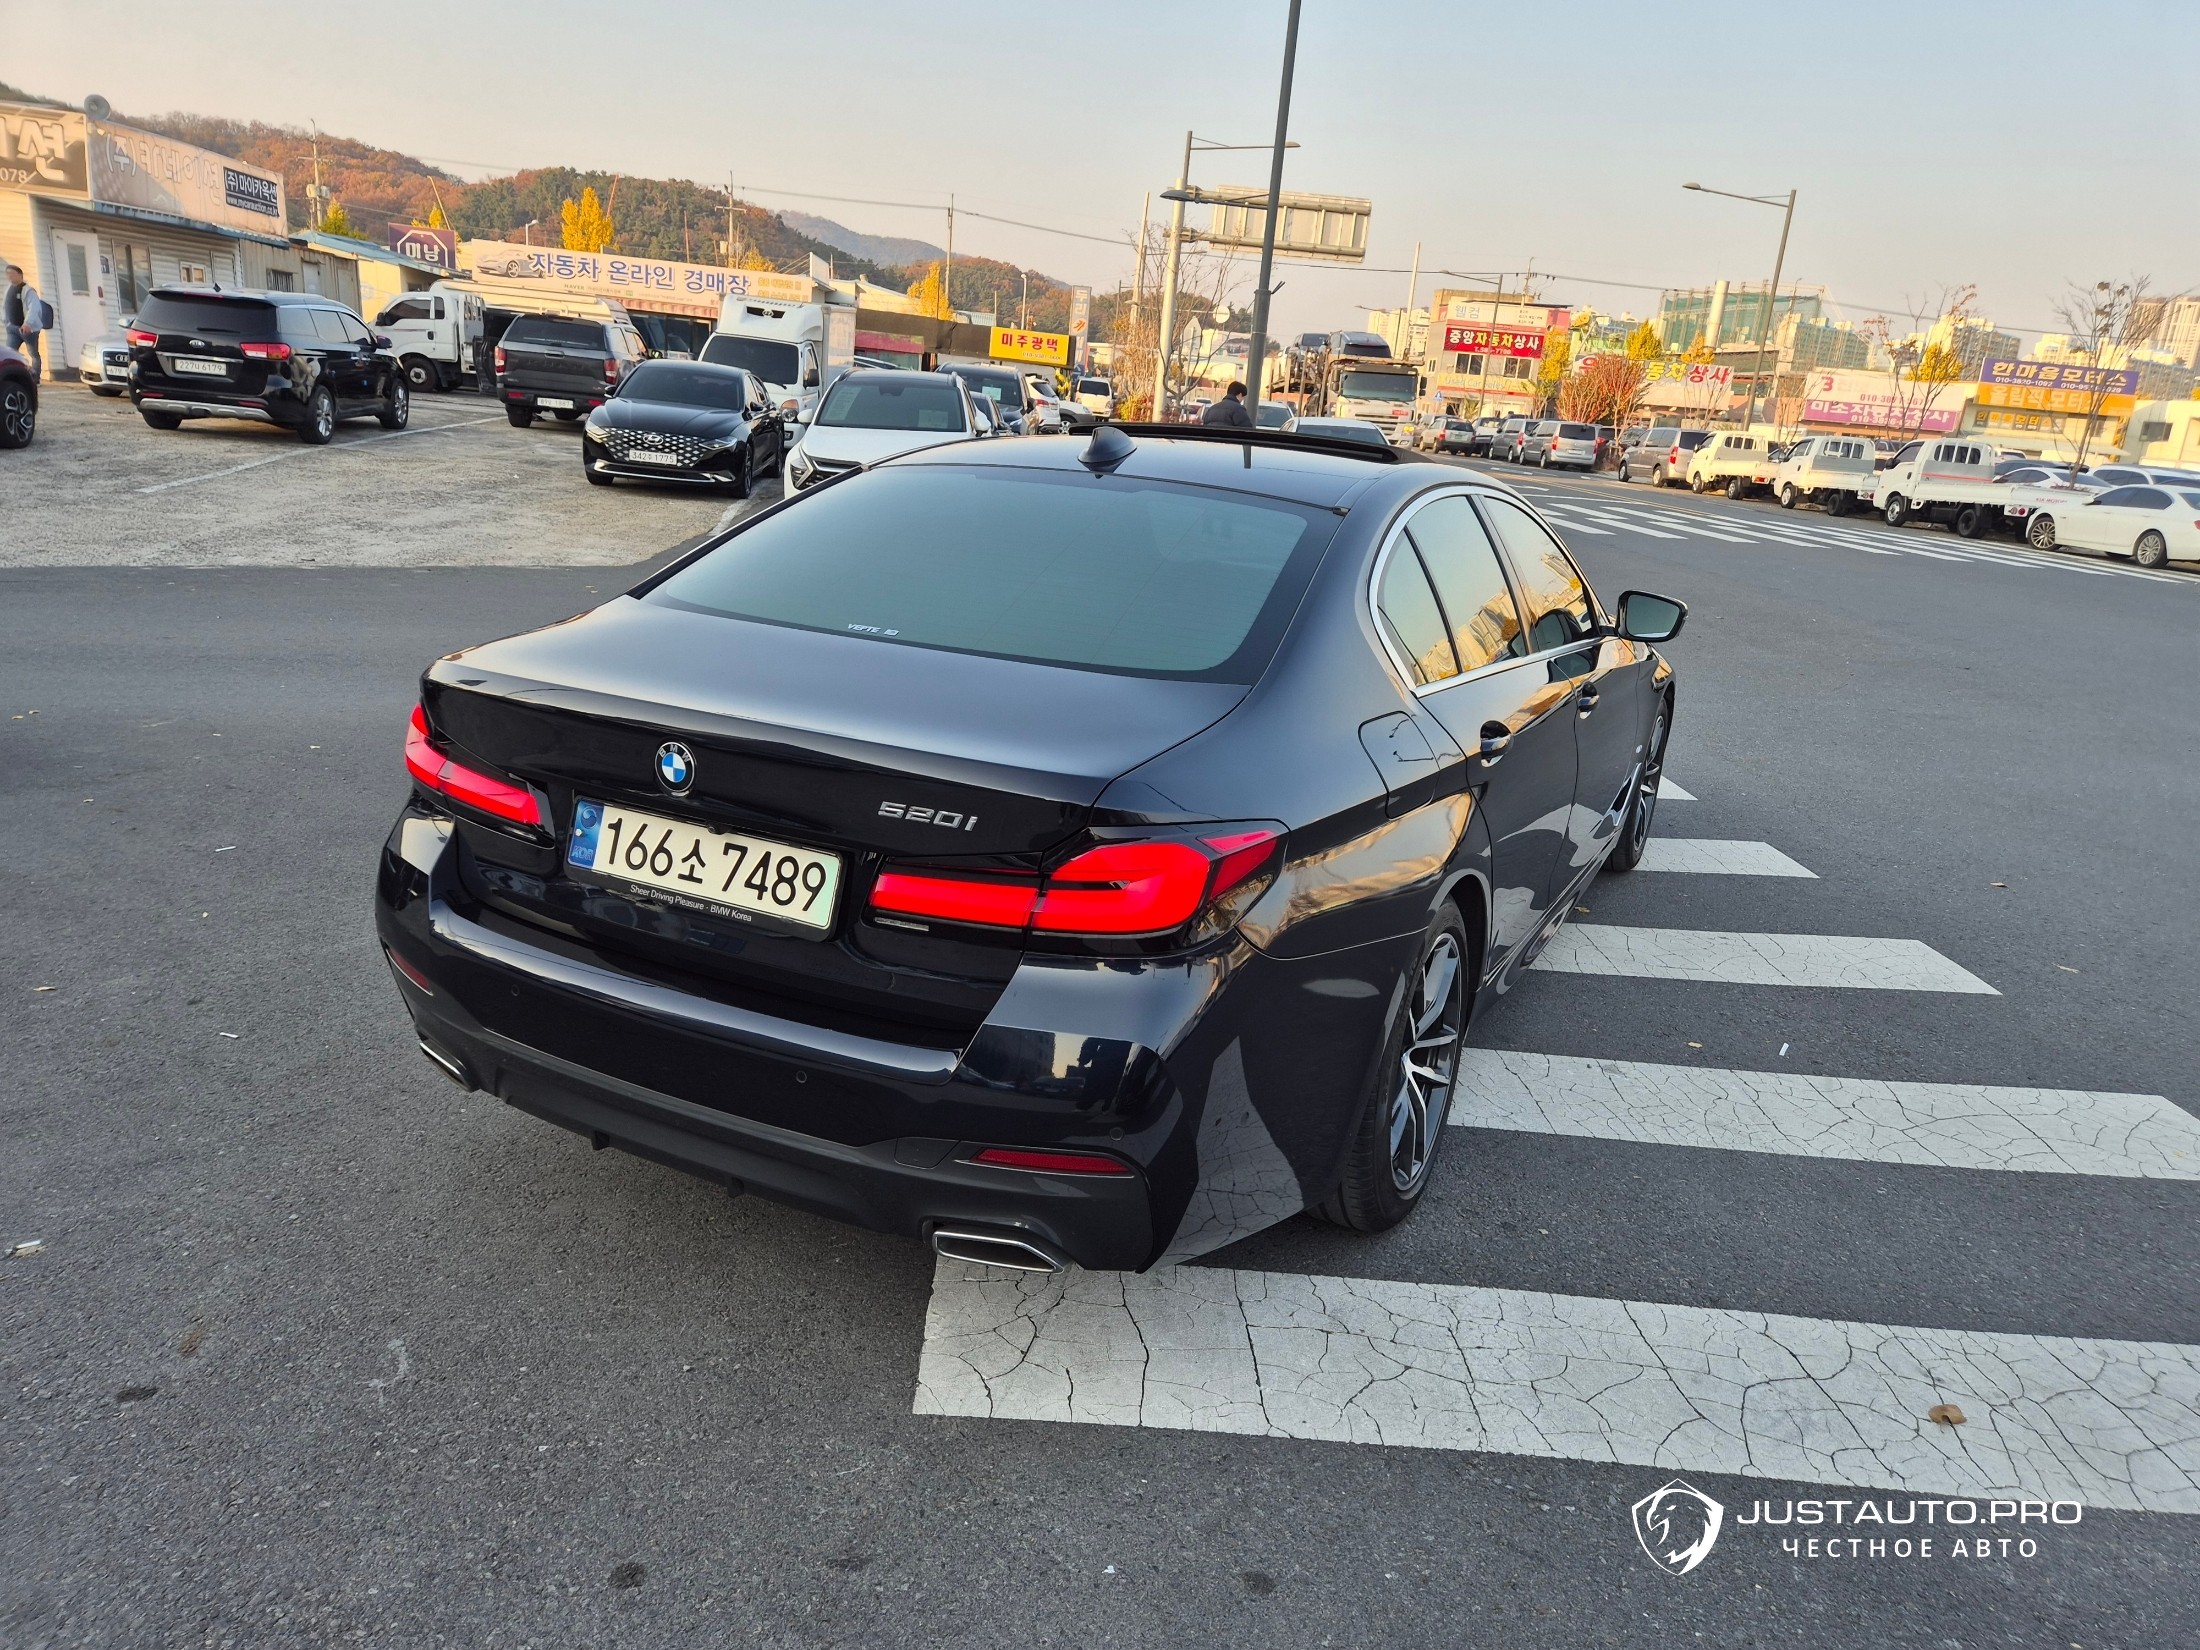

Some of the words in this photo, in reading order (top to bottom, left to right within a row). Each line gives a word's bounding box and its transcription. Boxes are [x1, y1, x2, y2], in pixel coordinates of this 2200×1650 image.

[224, 169, 277, 203] (주)마이카옥션
[532, 253, 600, 282] 자동차
[608, 260, 674, 290] 온라인
[684, 270, 750, 295] 경매장
[1455, 304, 1480, 319] 웰컴
[1001, 333, 1058, 352] 미주광택
[1449, 330, 1539, 350] 중앙자동차상사
[202, 362, 223, 372] 6179
[1992, 362, 2127, 387] 한마음모터스
[658, 744, 691, 763] BMW
[878, 800, 978, 832] 520i
[571, 845, 594, 861] KOR
[608, 817, 706, 884] 166소
[721, 842, 827, 912] 7489
[630, 884, 651, 897] Sheer
[650, 889, 674, 905] Driving
[675, 895, 704, 910] Pleasure
[710, 905, 731, 917] BMW
[731, 909, 752, 922] Korea
